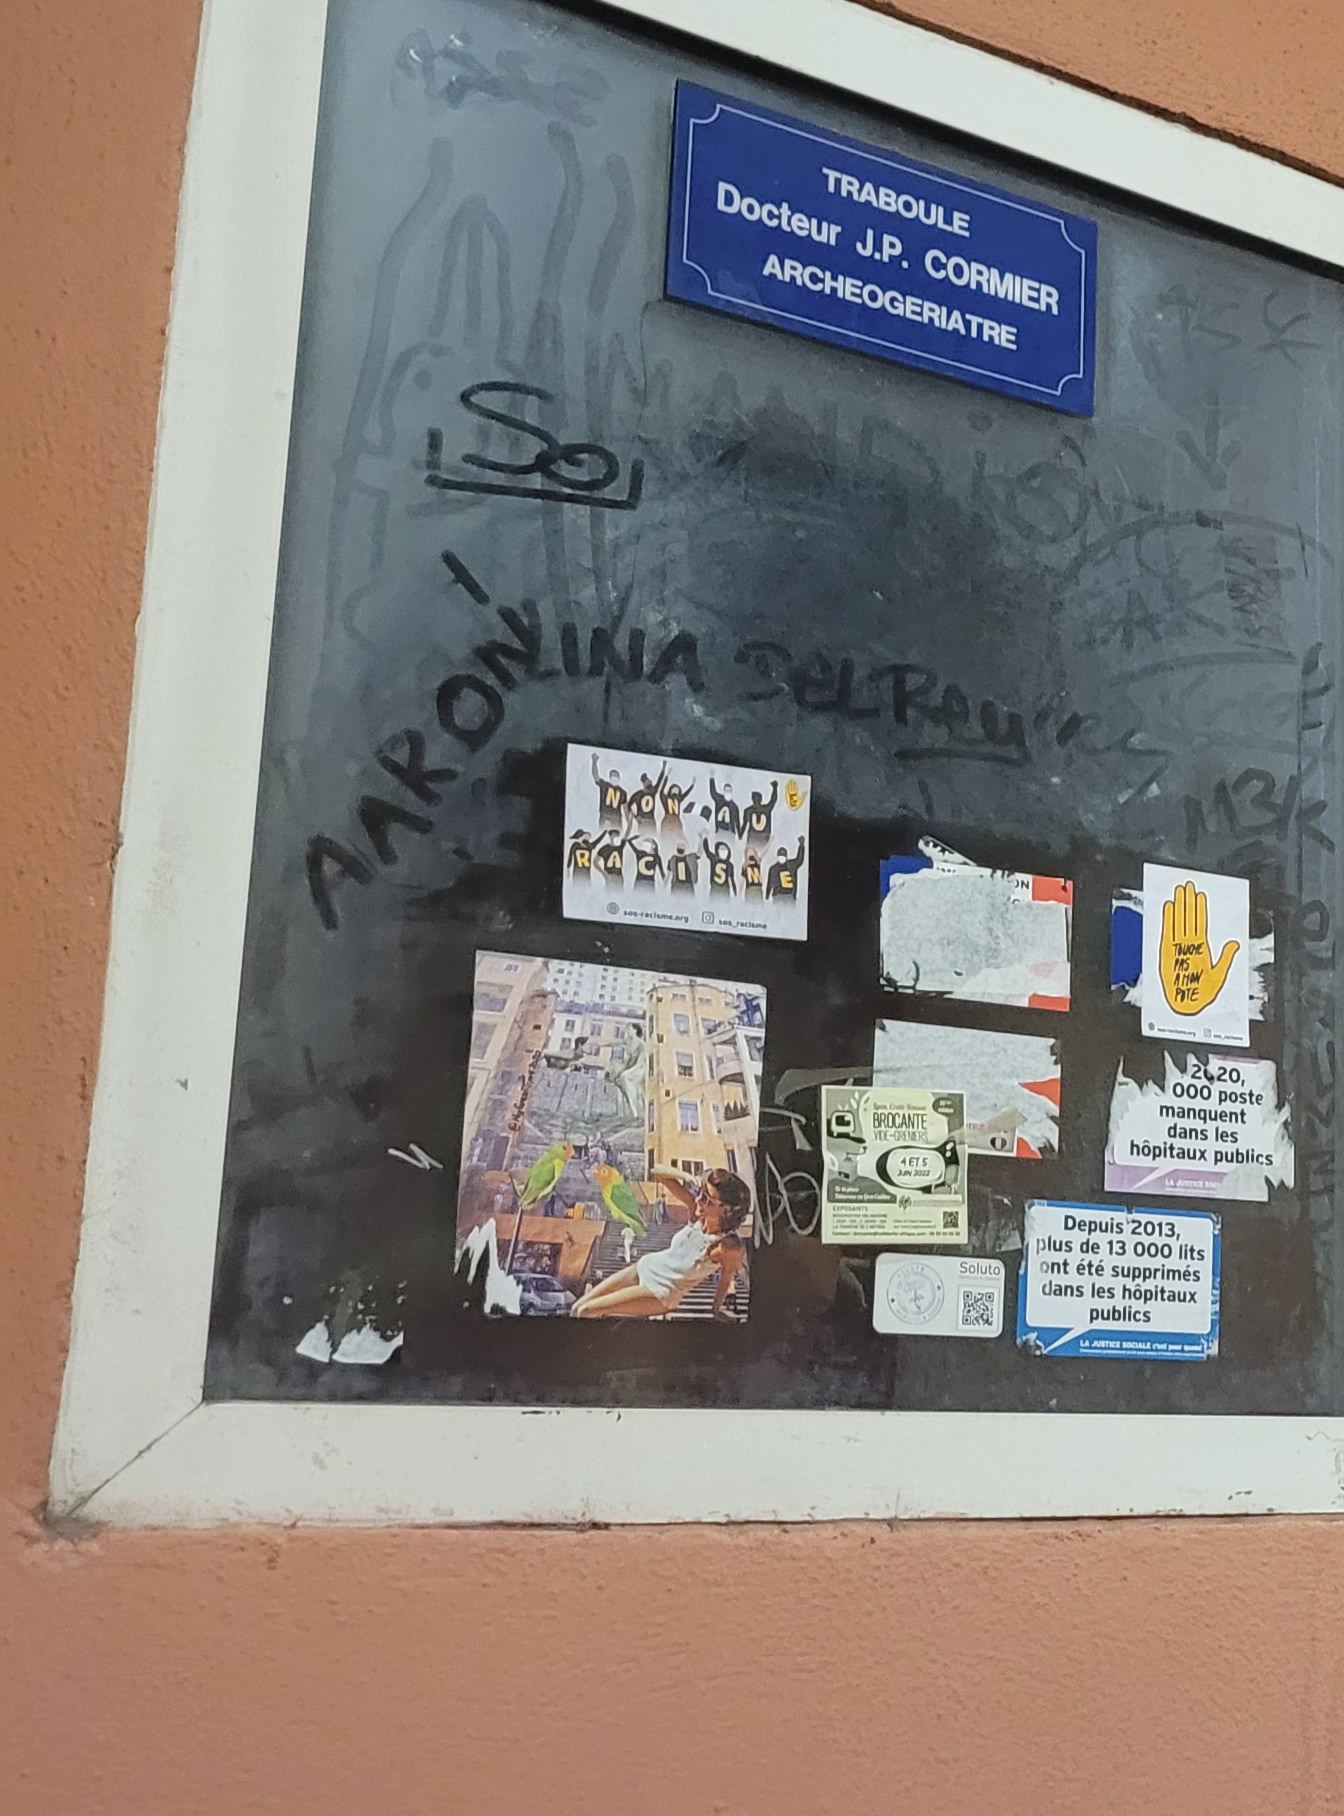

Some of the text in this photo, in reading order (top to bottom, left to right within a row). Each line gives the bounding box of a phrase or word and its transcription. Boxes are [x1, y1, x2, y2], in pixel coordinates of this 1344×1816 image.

[822, 166, 970, 238] TRABOULE
[716, 181, 1059, 316] Docteur J.P. CORMIER
[762, 253, 1018, 352] ARCHEOGERIATRE
[606, 786, 767, 833] NON AU
[575, 848, 794, 890] RACISME
[622, 908, 689, 924] sos-racisme.org
[1172, 941, 1205, 957] TOUCHE
[1173, 958, 1190, 972] PAS
[1173, 972, 1181, 987] A
[1174, 987, 1200, 1003] POTE
[1172, 1082, 1213, 1100] 000
[872, 1112, 928, 1130] BROCANTE
[1159, 1104, 1247, 1125] manquent
[873, 1129, 929, 1142] VIDE-GRENIERS
[1167, 1122, 1239, 1144] dans les
[900, 1156, 929, 1167] 4 ET 5
[1130, 1139, 1274, 1166] hôpitaux publics
[897, 1169, 931, 1177] JUIN 2022
[1063, 1214, 1181, 1242] Depuis 2013,
[1036, 1235, 1206, 1262] plus de 13 000 lits
[959, 1261, 1001, 1276] Soluto
[1040, 1258, 1202, 1283] ont été supprimés
[1042, 1280, 1198, 1305] dans les hôpitaux
[1089, 1306, 1152, 1325] publics
[1079, 1339, 1089, 1347] LA
[1091, 1340, 1121, 1349] JUSTICE
[1122, 1341, 1151, 1350] SOCIALE
